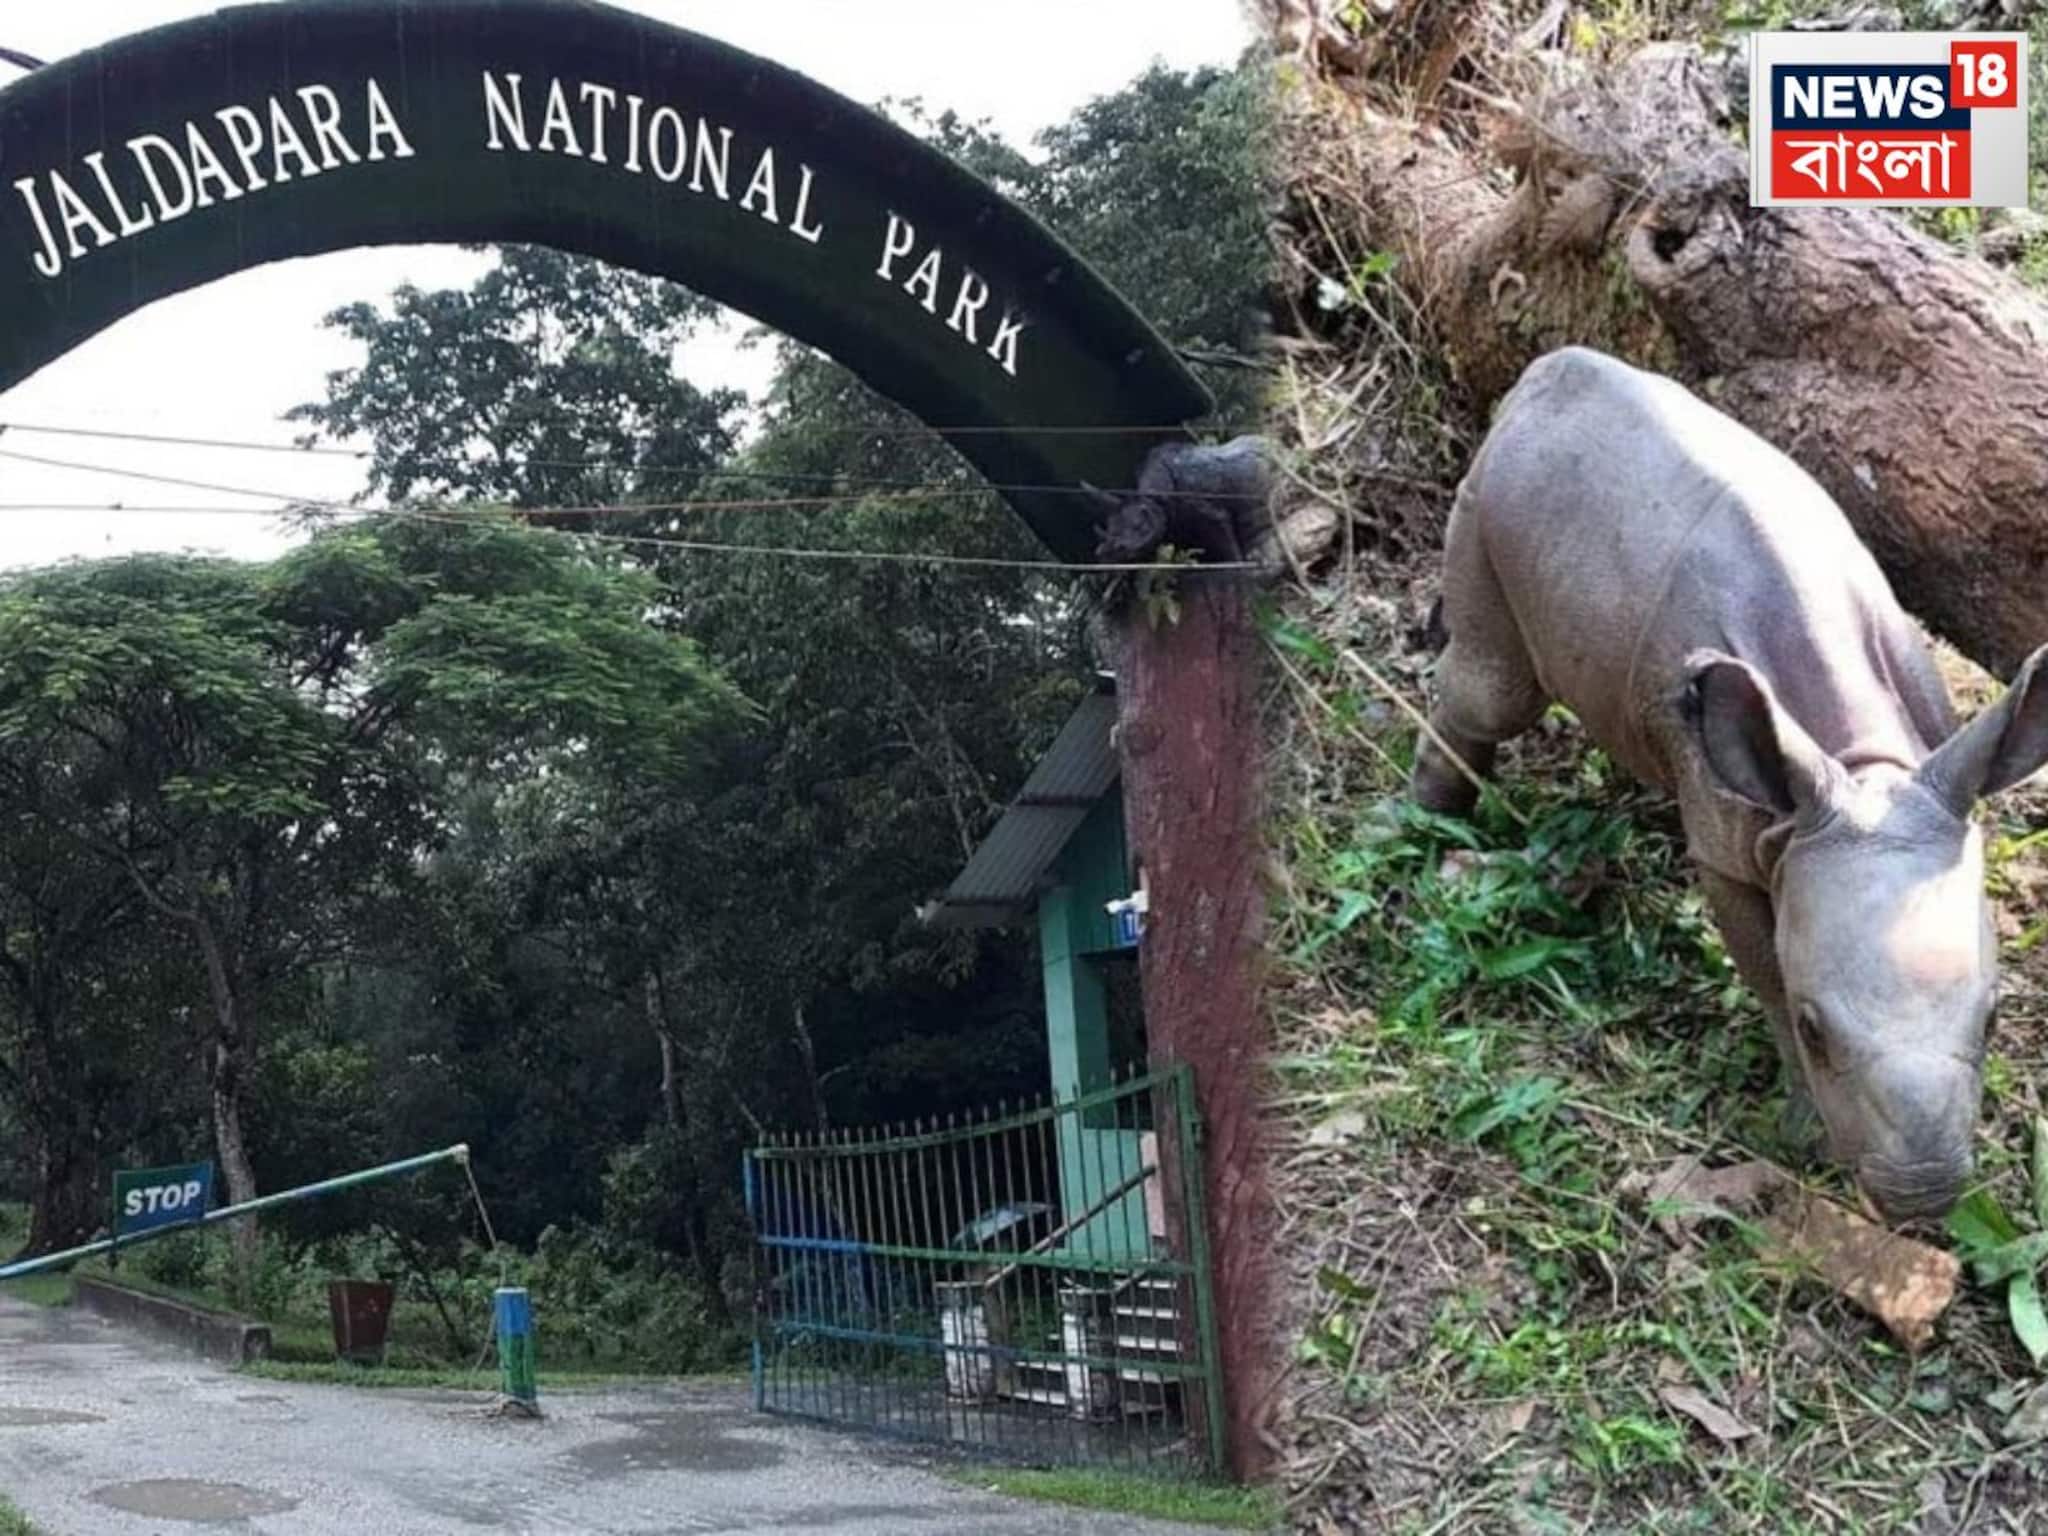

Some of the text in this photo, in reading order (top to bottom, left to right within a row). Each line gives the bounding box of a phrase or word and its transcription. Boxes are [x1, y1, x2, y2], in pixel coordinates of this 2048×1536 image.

[13, 70, 1028, 377] JALDAPARA NATIONAL PARK
[124, 1180, 201, 1216] STOP
